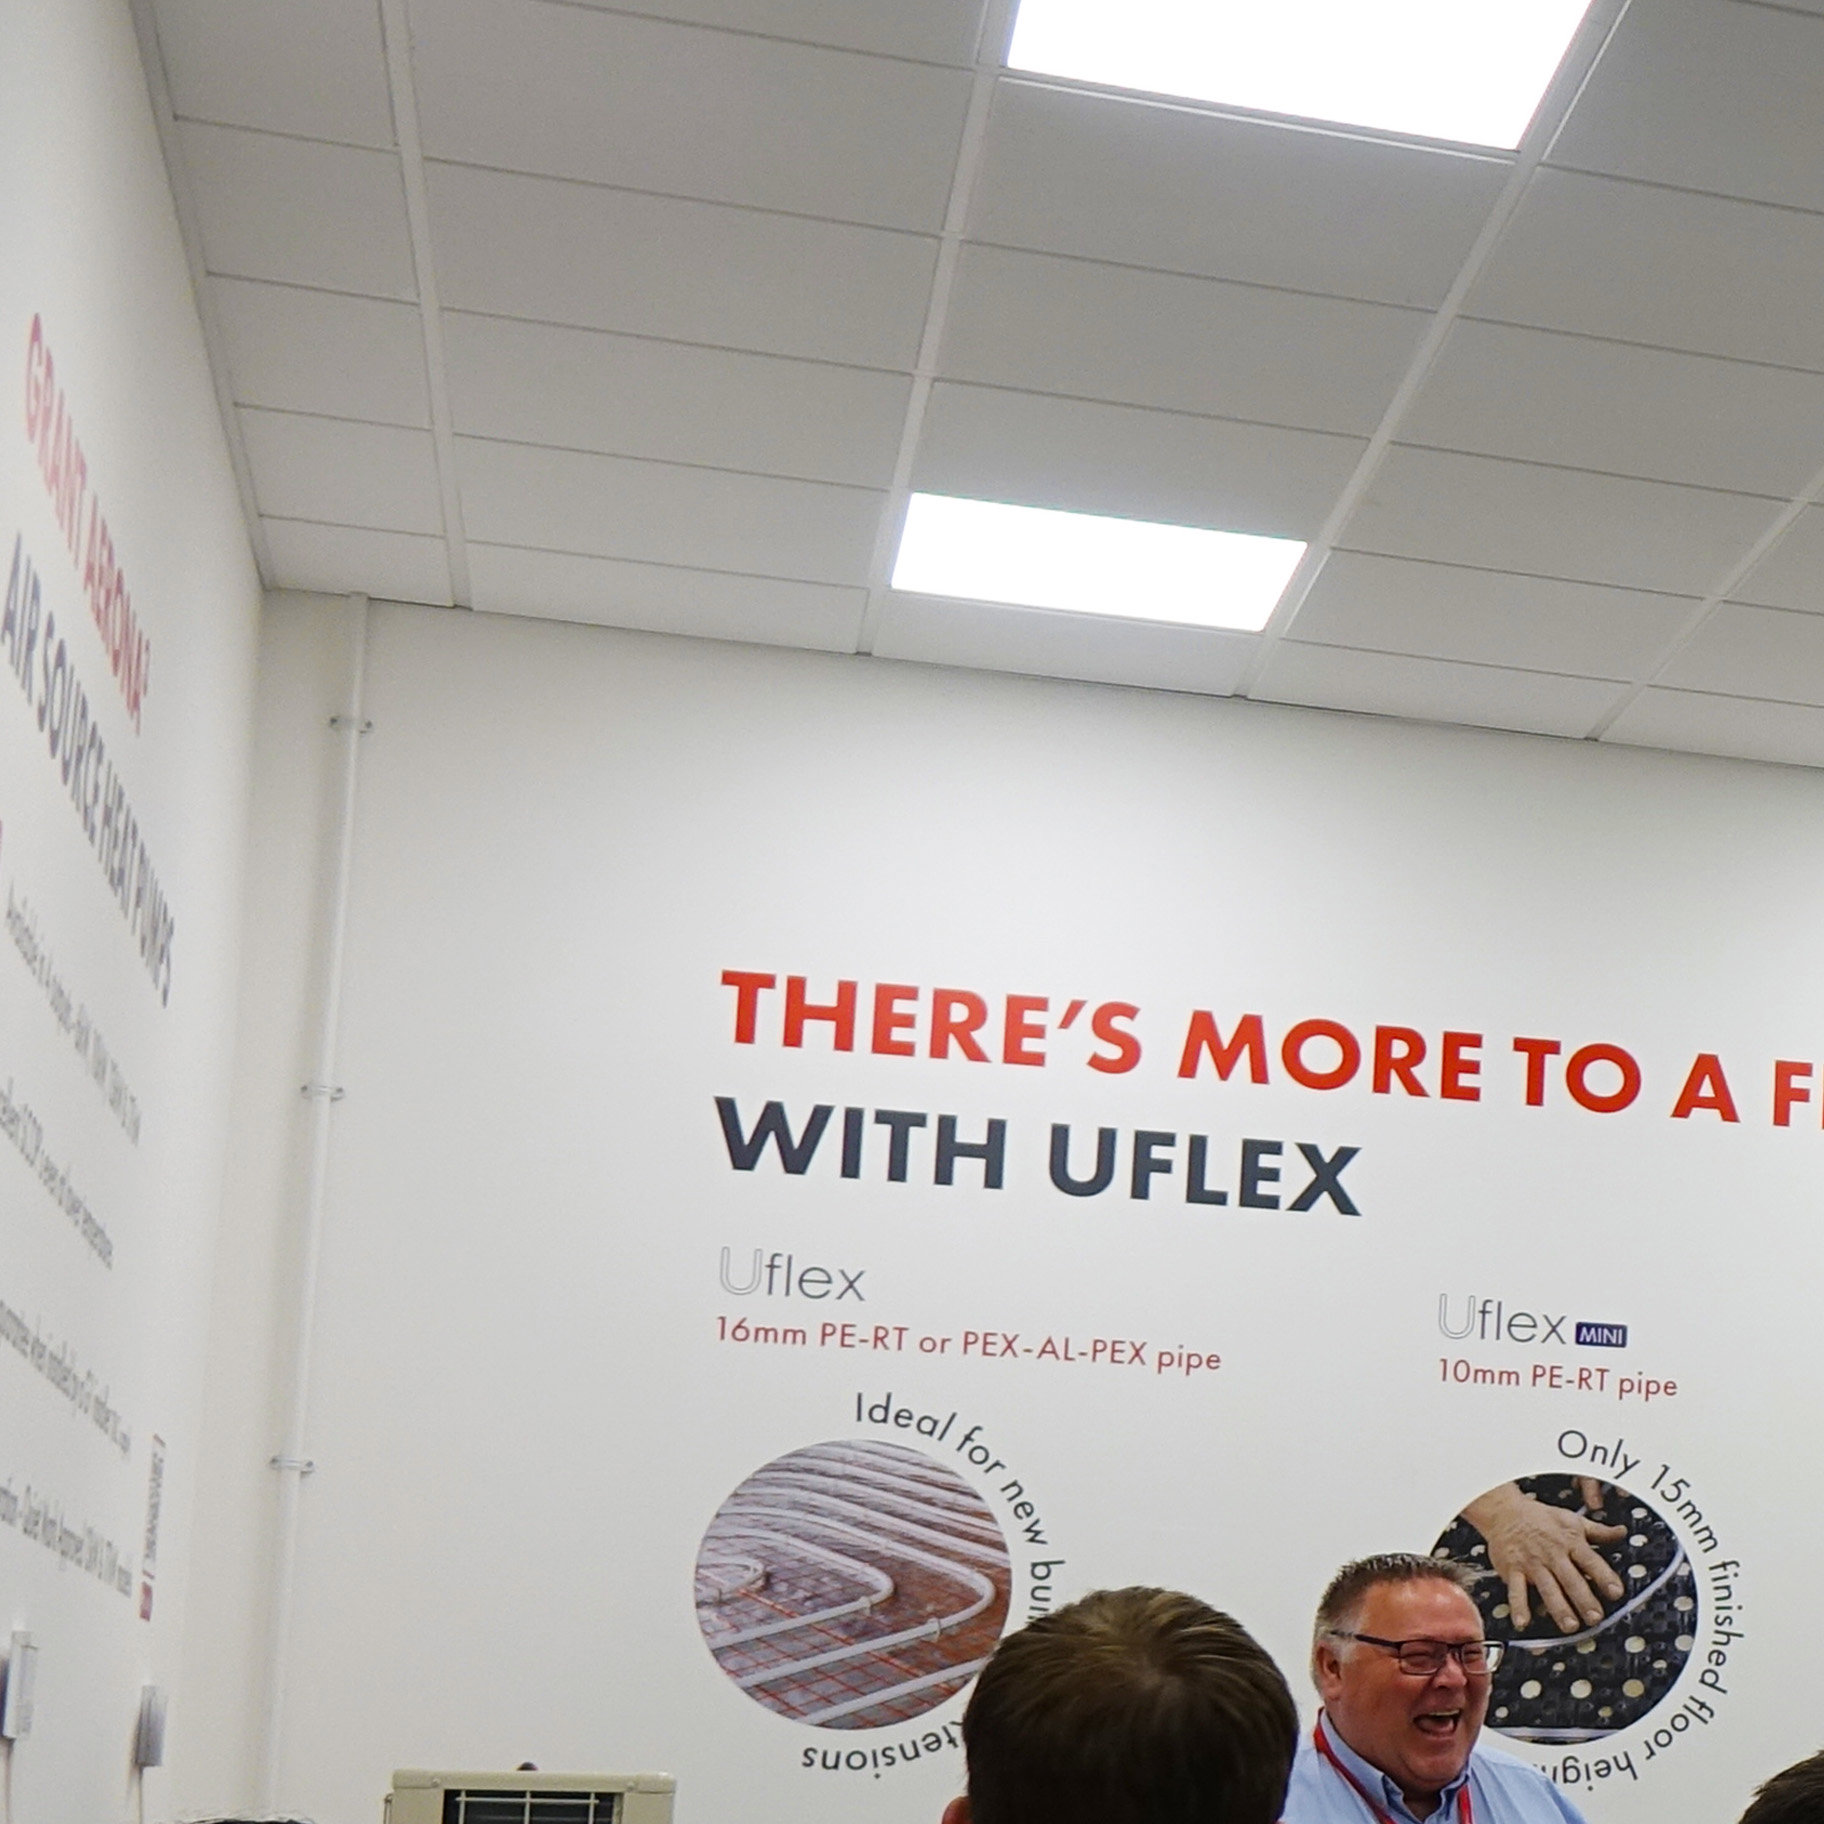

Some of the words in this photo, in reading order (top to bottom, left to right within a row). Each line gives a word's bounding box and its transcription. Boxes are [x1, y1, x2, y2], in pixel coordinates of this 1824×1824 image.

[721, 969, 1142, 1075] THERE'S
[1177, 1008, 1483, 1101] MORE
[1513, 1036, 1642, 1114] TO
[1672, 1053, 1740, 1123] A
[715, 1096, 1007, 1190] WITH
[1048, 1123, 1362, 1216] UFLEX
[720, 1246, 867, 1301] Uflex
[716, 1316, 806, 1346] 16mm
[820, 1322, 909, 1352] PE-RT
[919, 1334, 952, 1355] or
[963, 1331, 1147, 1367] PEX-AL-PEX
[1158, 1345, 1222, 1376] pipe
[1439, 1293, 1567, 1345] Uflex
[1579, 1325, 1624, 1345] MINI
[1440, 1358, 1520, 1387] 10mm
[1531, 1364, 1610, 1392] PE-RT
[1619, 1372, 1678, 1402] pipe
[856, 1392, 957, 1441] Ideal
[956, 1425, 1006, 1474] for
[1000, 1479, 1048, 1546] new
[1558, 1430, 1640, 1480] Only
[1650, 1464, 1718, 1553] 15mm
[1699, 1560, 1744, 1694] finished
[1644, 1696, 1715, 1760] floor
